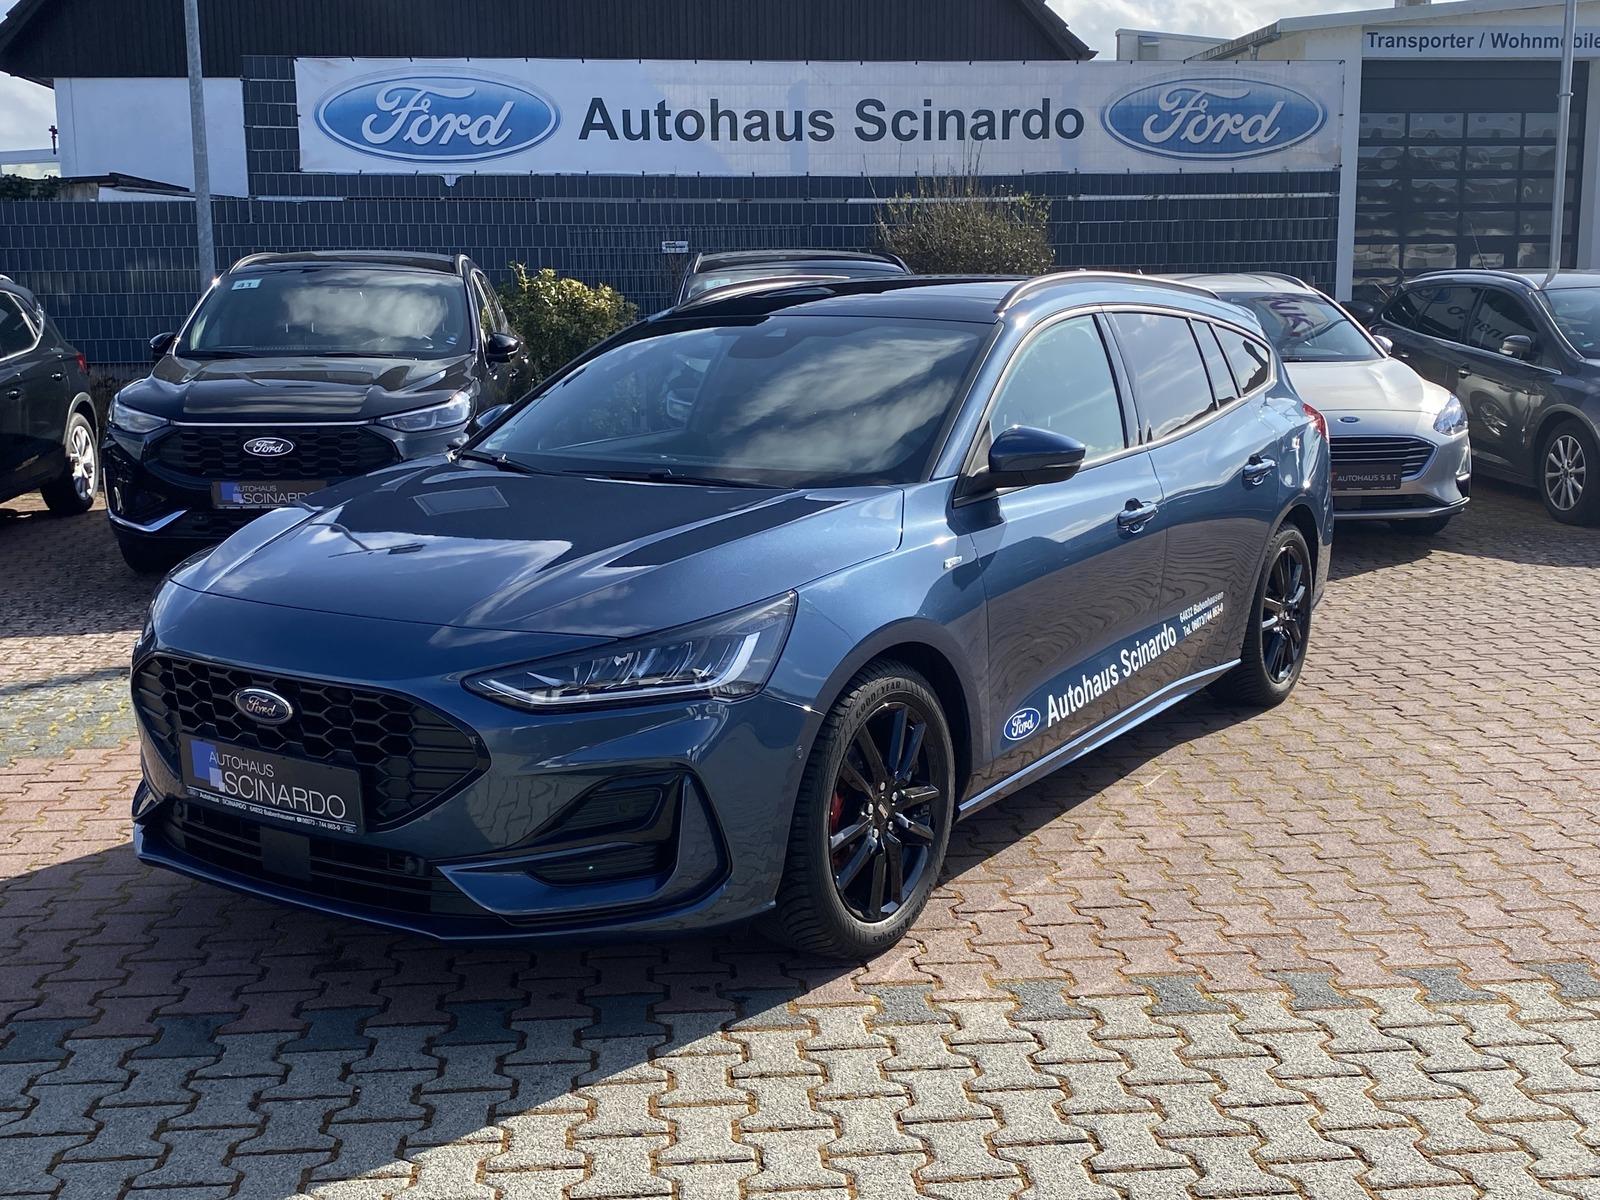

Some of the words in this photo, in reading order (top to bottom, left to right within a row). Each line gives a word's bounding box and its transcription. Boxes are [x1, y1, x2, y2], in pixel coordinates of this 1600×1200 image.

[1366, 32, 1474, 52] Transporter
[1479, 32, 1485, 48] /
[1490, 32, 1600, 49] Wohnmbile
[361, 80, 516, 146] Ford
[578, 97, 835, 142] Autohaus
[854, 97, 1085, 142] Scinardo
[1142, 81, 1287, 145] Ford
[252, 439, 284, 453] Ford
[233, 485, 277, 493] AUTOHAUS
[1337, 474, 1379, 482] AUTOHAUS
[1047, 663, 1119, 728] Autohaus
[1120, 623, 1177, 678] Scinardo
[246, 695, 277, 717] Ford
[1011, 713, 1034, 737] Ford
[209, 751, 275, 777] AUTOHAUS
[224, 771, 346, 818] SCINARDO
